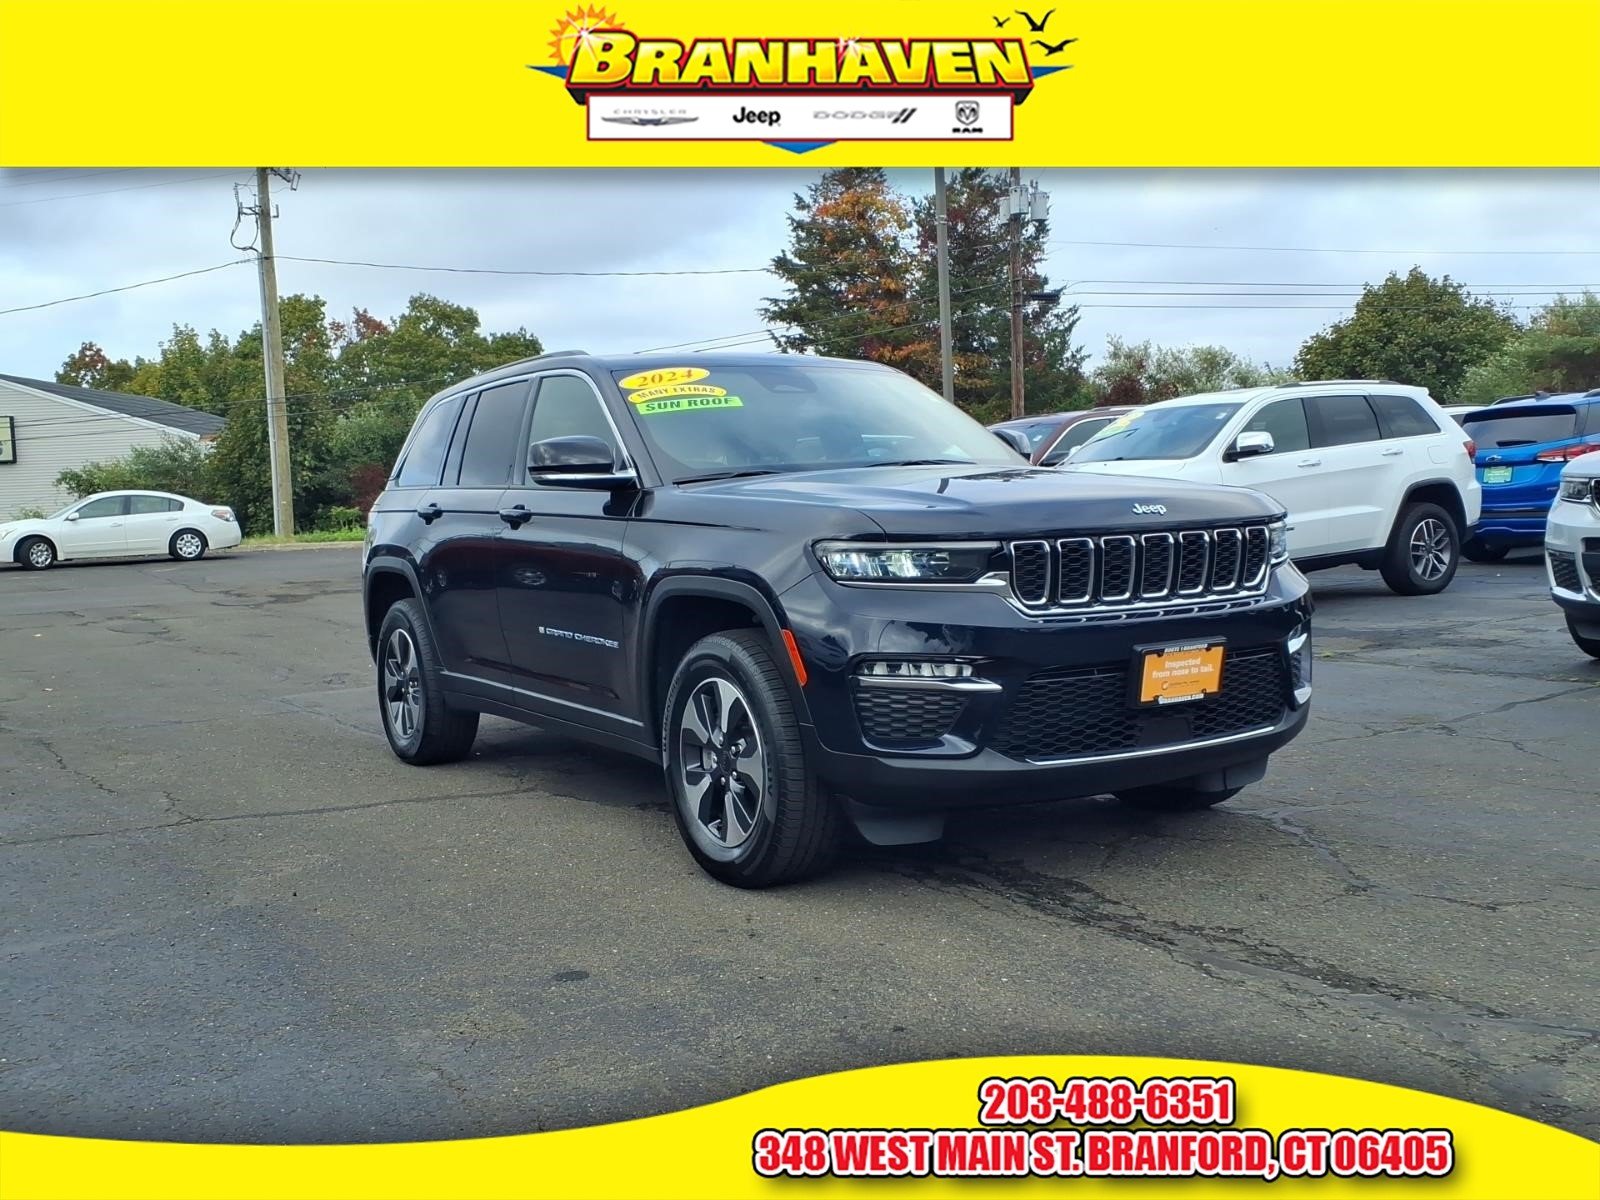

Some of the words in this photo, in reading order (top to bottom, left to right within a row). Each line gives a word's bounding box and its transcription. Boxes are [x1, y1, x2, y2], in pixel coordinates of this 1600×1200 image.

[638, 369, 692, 386] 2024
[637, 388, 669, 400] MANY
[674, 386, 716, 394] EXTRAS
[645, 400, 681, 412] SUN
[687, 397, 734, 408] ROOF
[1132, 503, 1167, 515] Jeep
[1165, 658, 1201, 669] Inspected
[1152, 670, 1170, 678] from
[1171, 668, 1190, 676] nose
